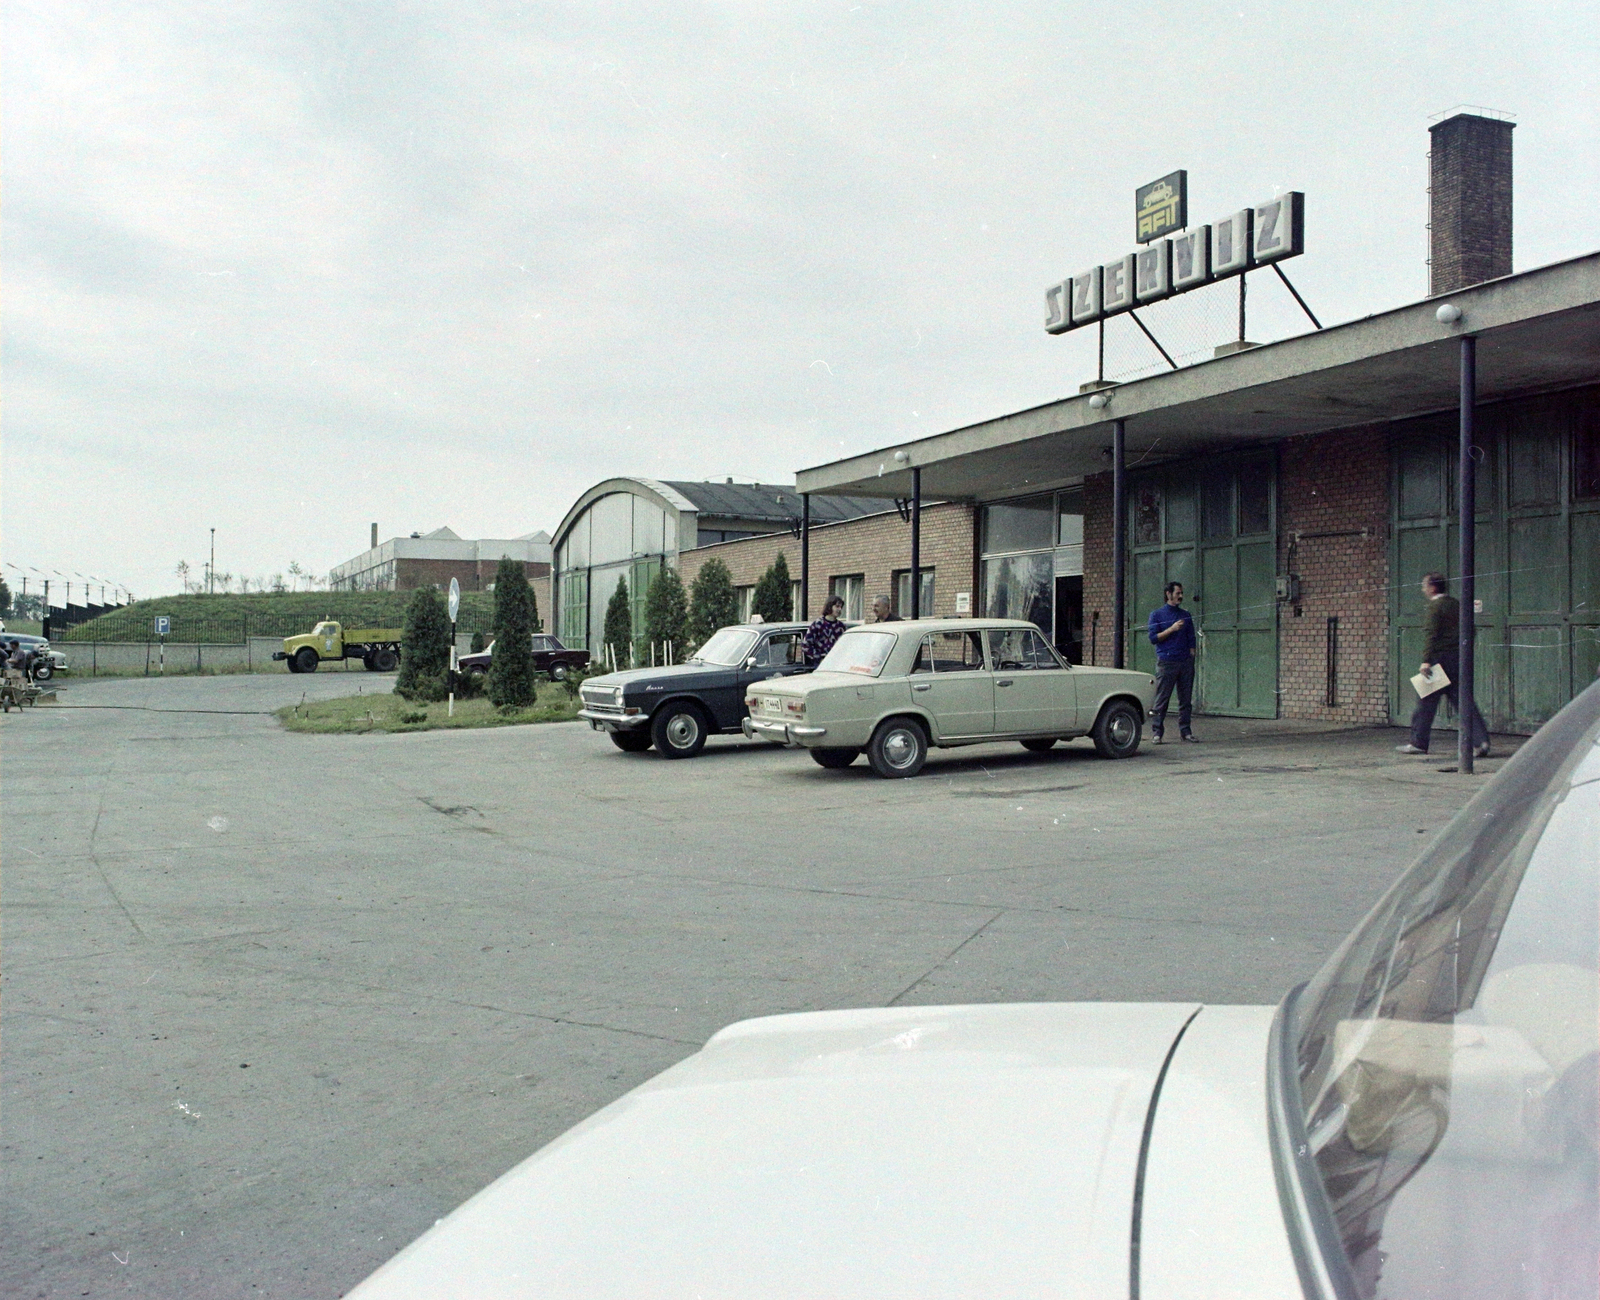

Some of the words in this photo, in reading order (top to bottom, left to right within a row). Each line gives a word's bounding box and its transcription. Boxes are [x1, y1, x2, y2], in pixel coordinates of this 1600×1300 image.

[1138, 194, 1180, 238] AFIT
[1045, 200, 1282, 326] SZERVIZ
[158, 618, 168, 632] P
